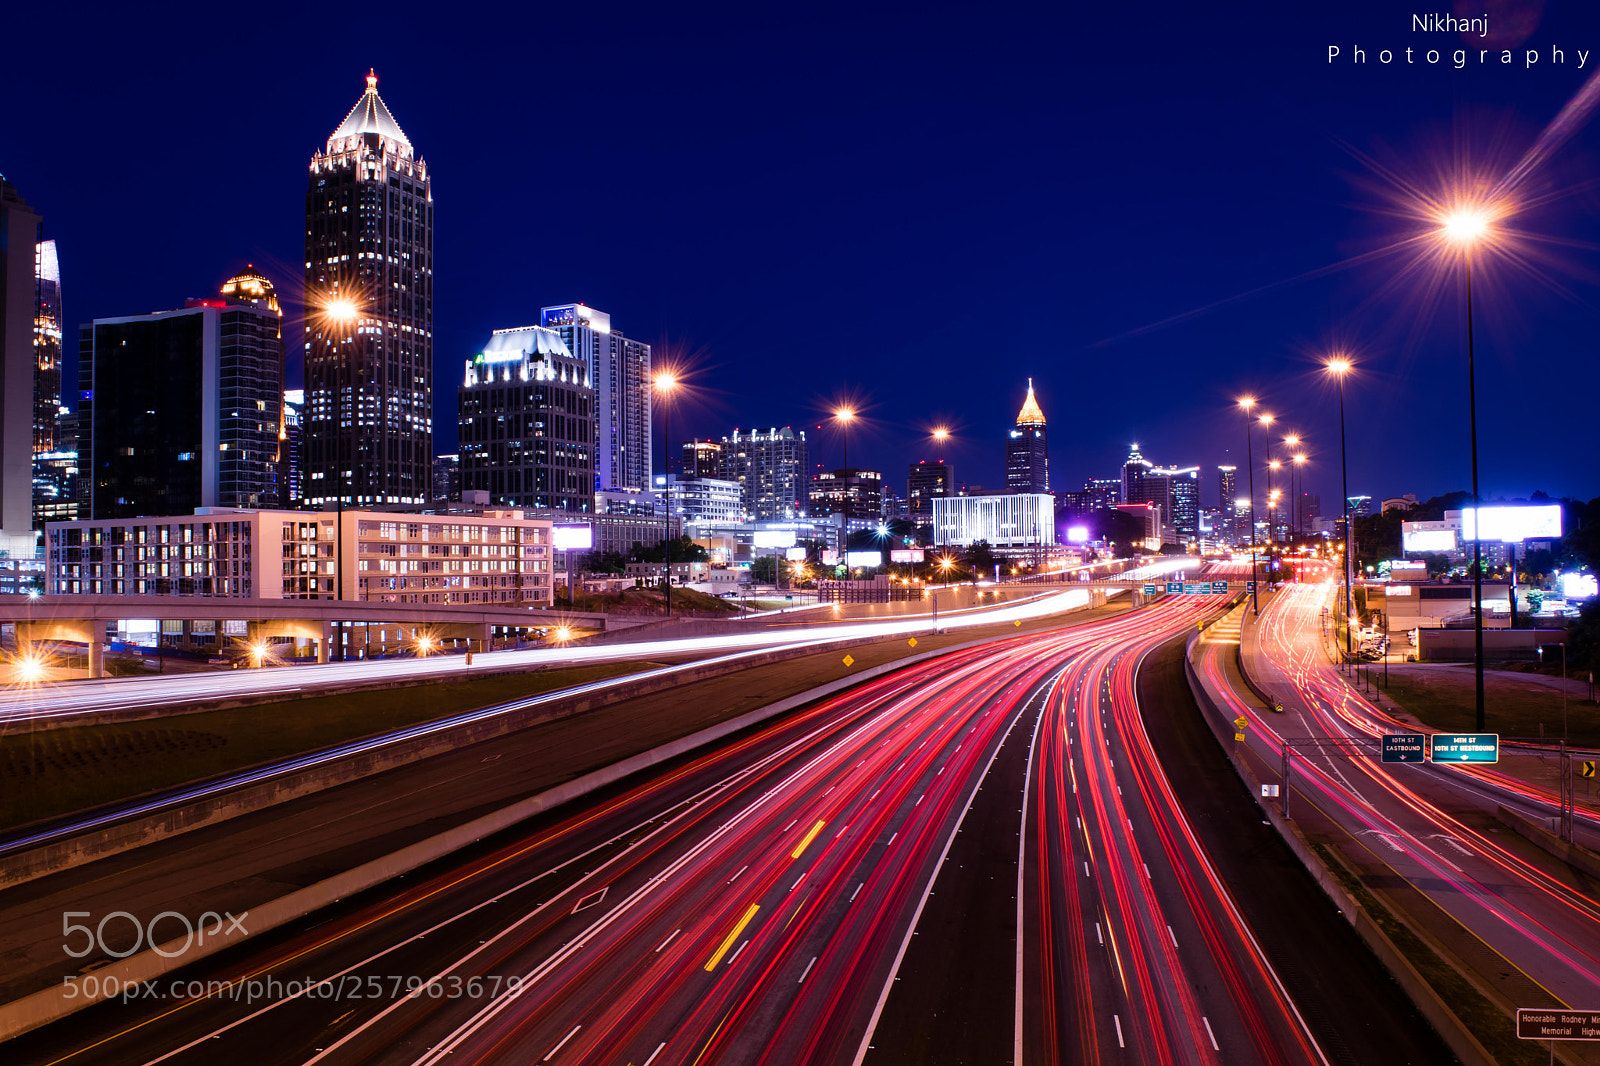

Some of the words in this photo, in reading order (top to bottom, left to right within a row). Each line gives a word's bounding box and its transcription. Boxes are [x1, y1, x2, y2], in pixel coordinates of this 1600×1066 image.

[1522, 1014, 1556, 1023] Honorable
[1561, 1015, 1587, 1025] Rodney
[1541, 1026, 1572, 1035] Memorial
